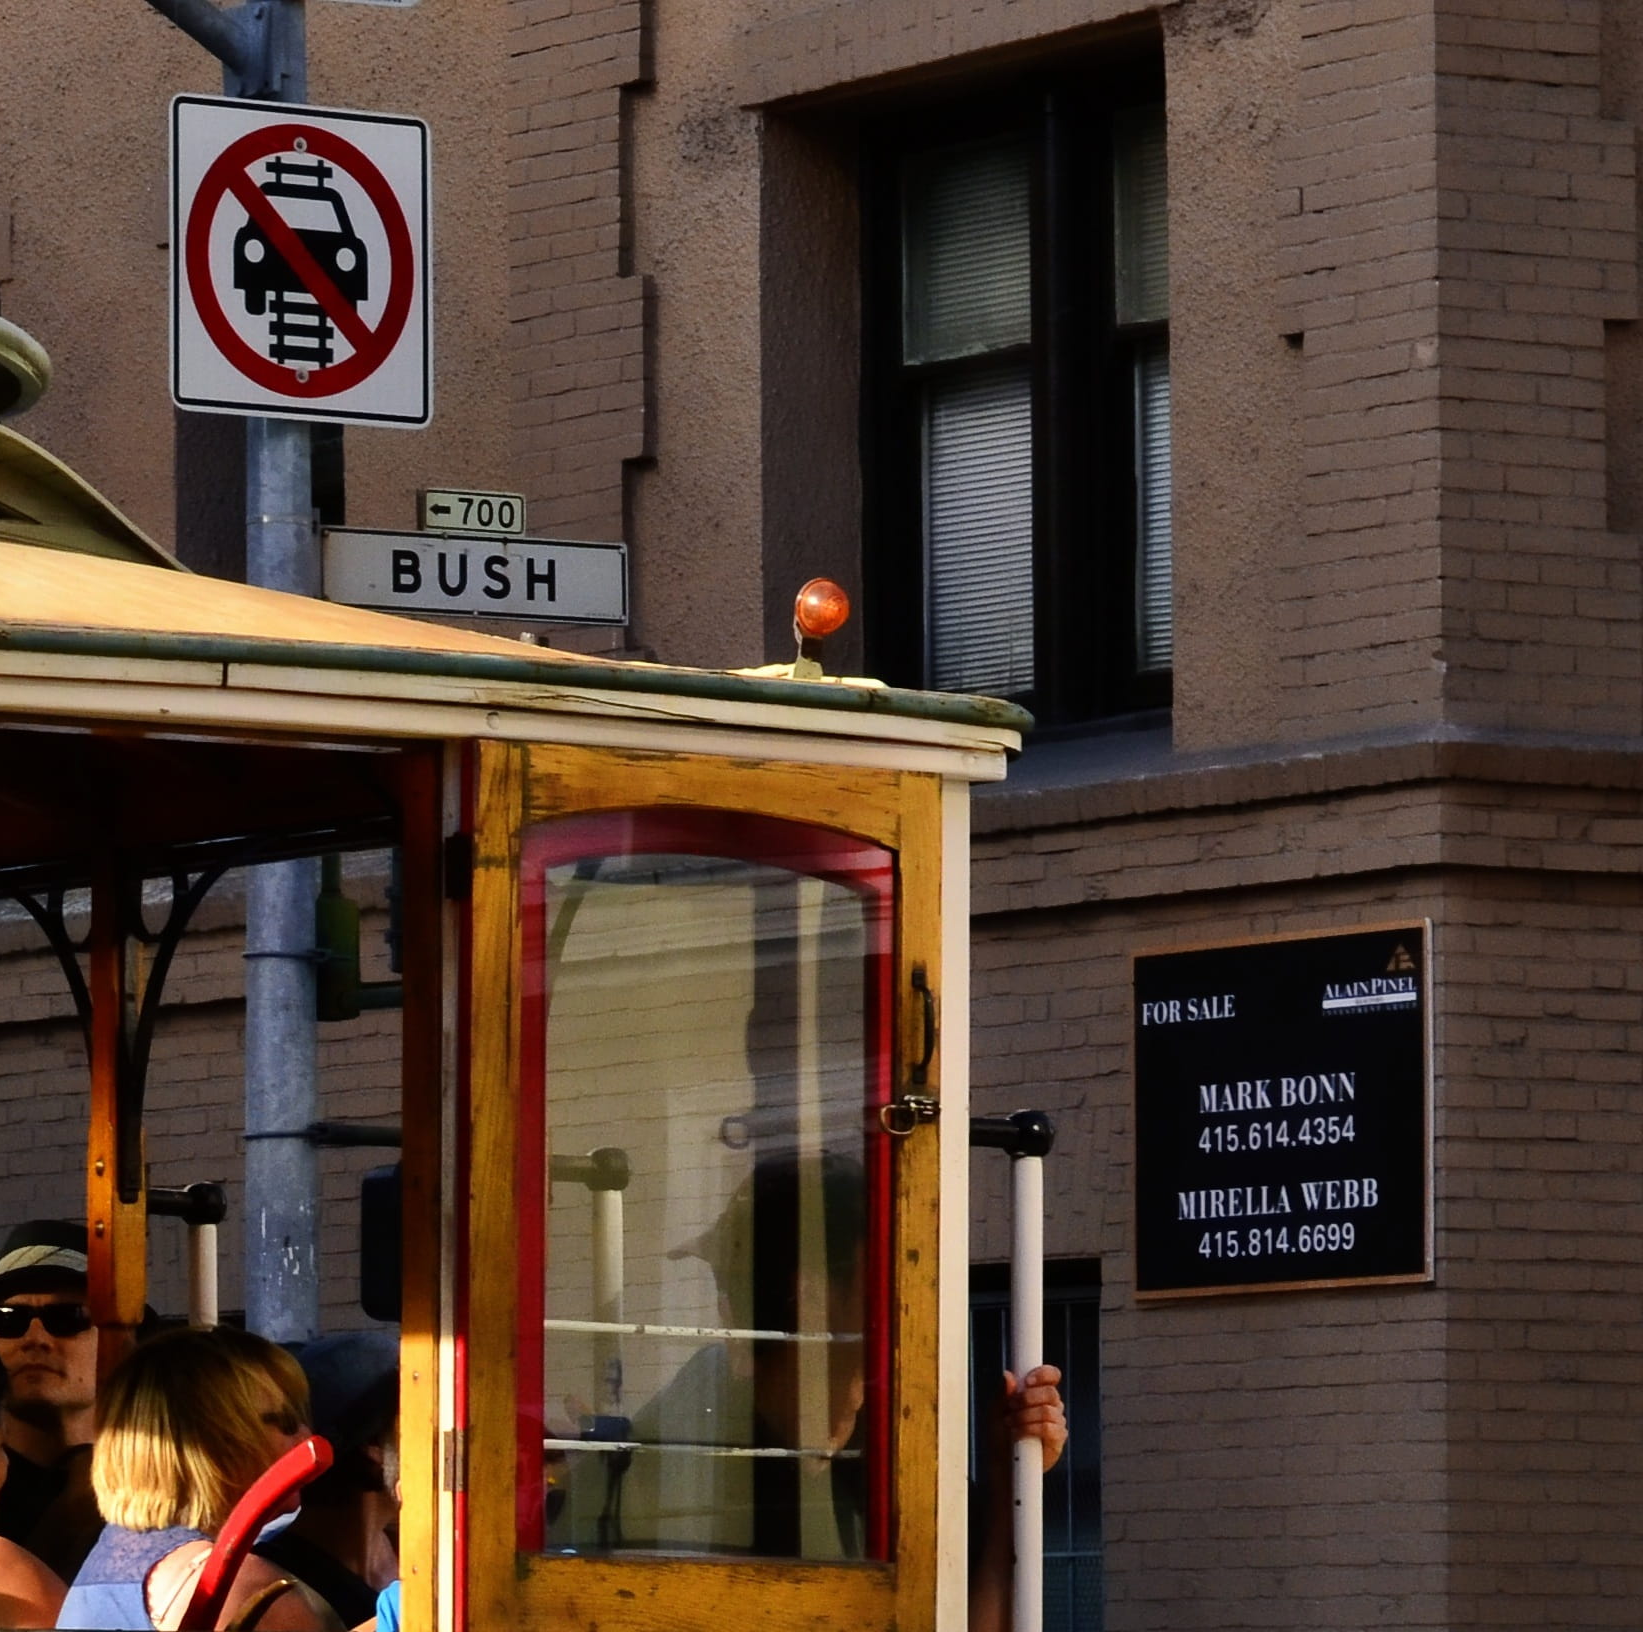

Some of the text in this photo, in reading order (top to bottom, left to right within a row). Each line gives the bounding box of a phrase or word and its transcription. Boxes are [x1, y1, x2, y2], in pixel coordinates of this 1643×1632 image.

[458, 498, 515, 528] 700
[392, 550, 557, 602] BUSH
[1142, 995, 1235, 1026] FOR SALE
[1199, 1072, 1355, 1113] MARK BONN
[1199, 1115, 1355, 1153] 415.614.4354
[1178, 1178, 1379, 1220] MIRELLA WEBB
[1199, 1223, 1355, 1259] 415.814.6699
